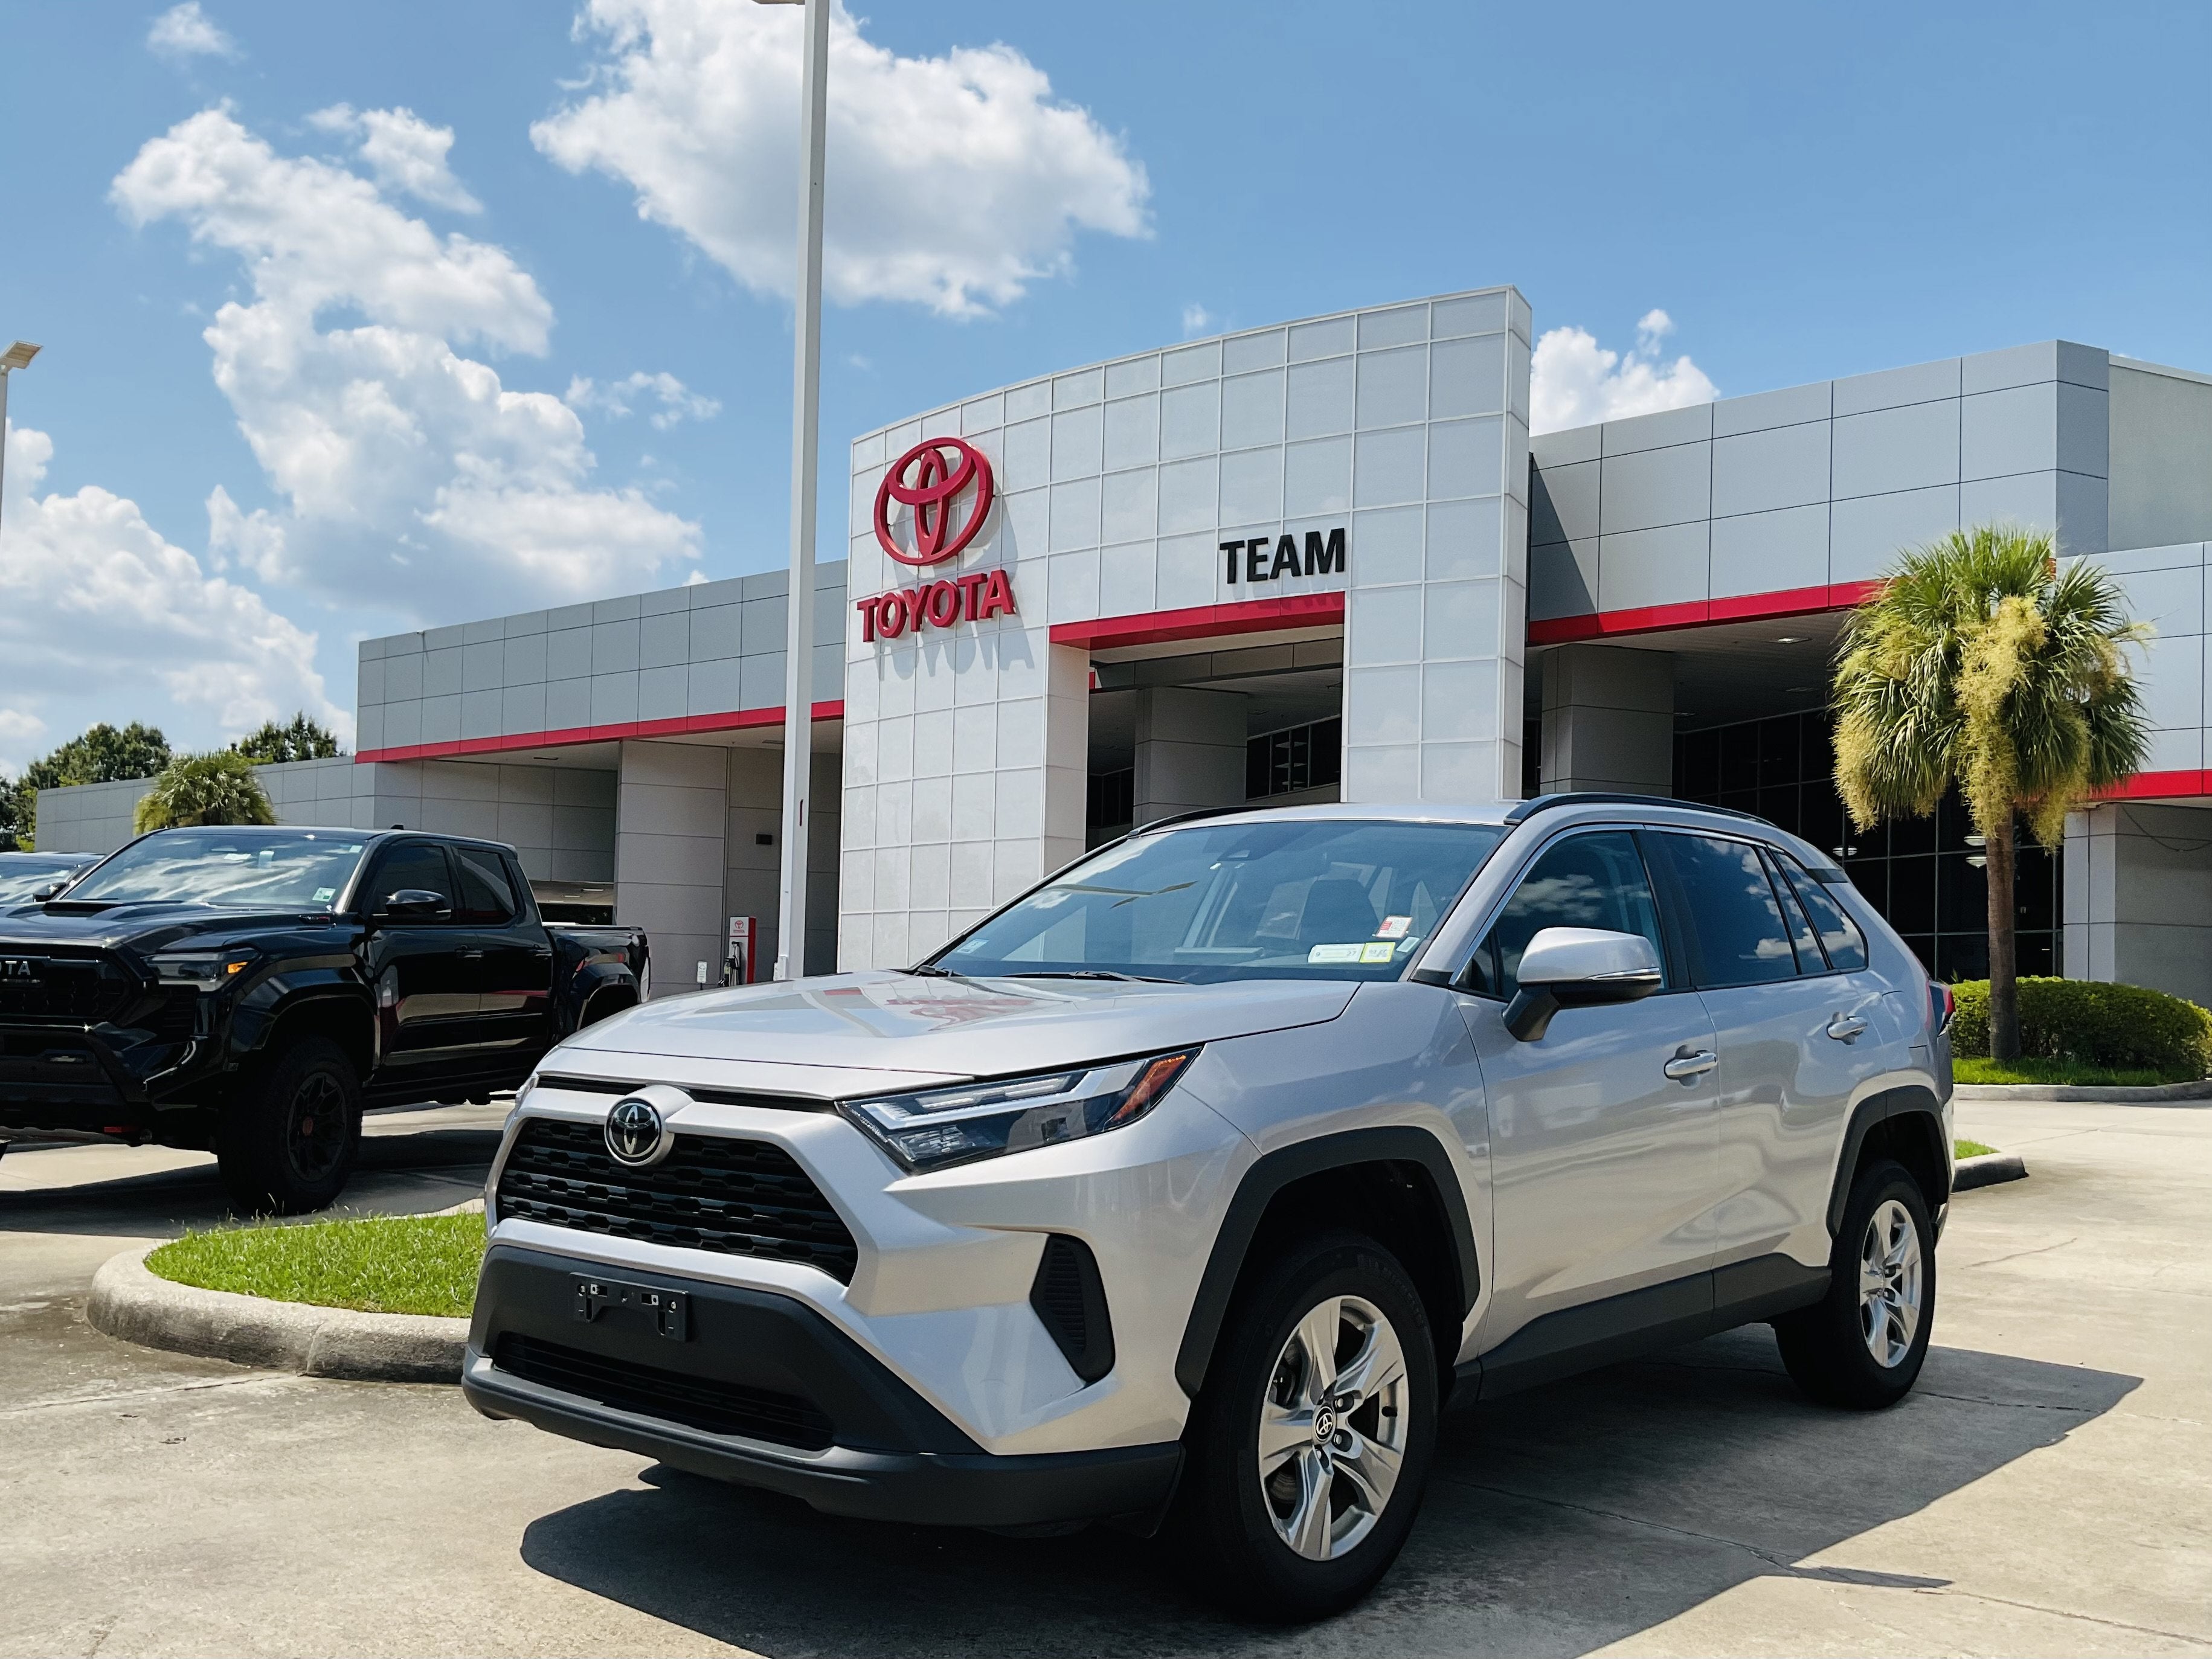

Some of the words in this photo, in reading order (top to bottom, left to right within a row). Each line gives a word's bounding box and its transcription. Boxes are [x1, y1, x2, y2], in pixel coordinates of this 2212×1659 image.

[1219, 527, 1345, 585] TEAM
[857, 569, 1017, 643] TOYOTA
[0, 960, 31, 975] TA
